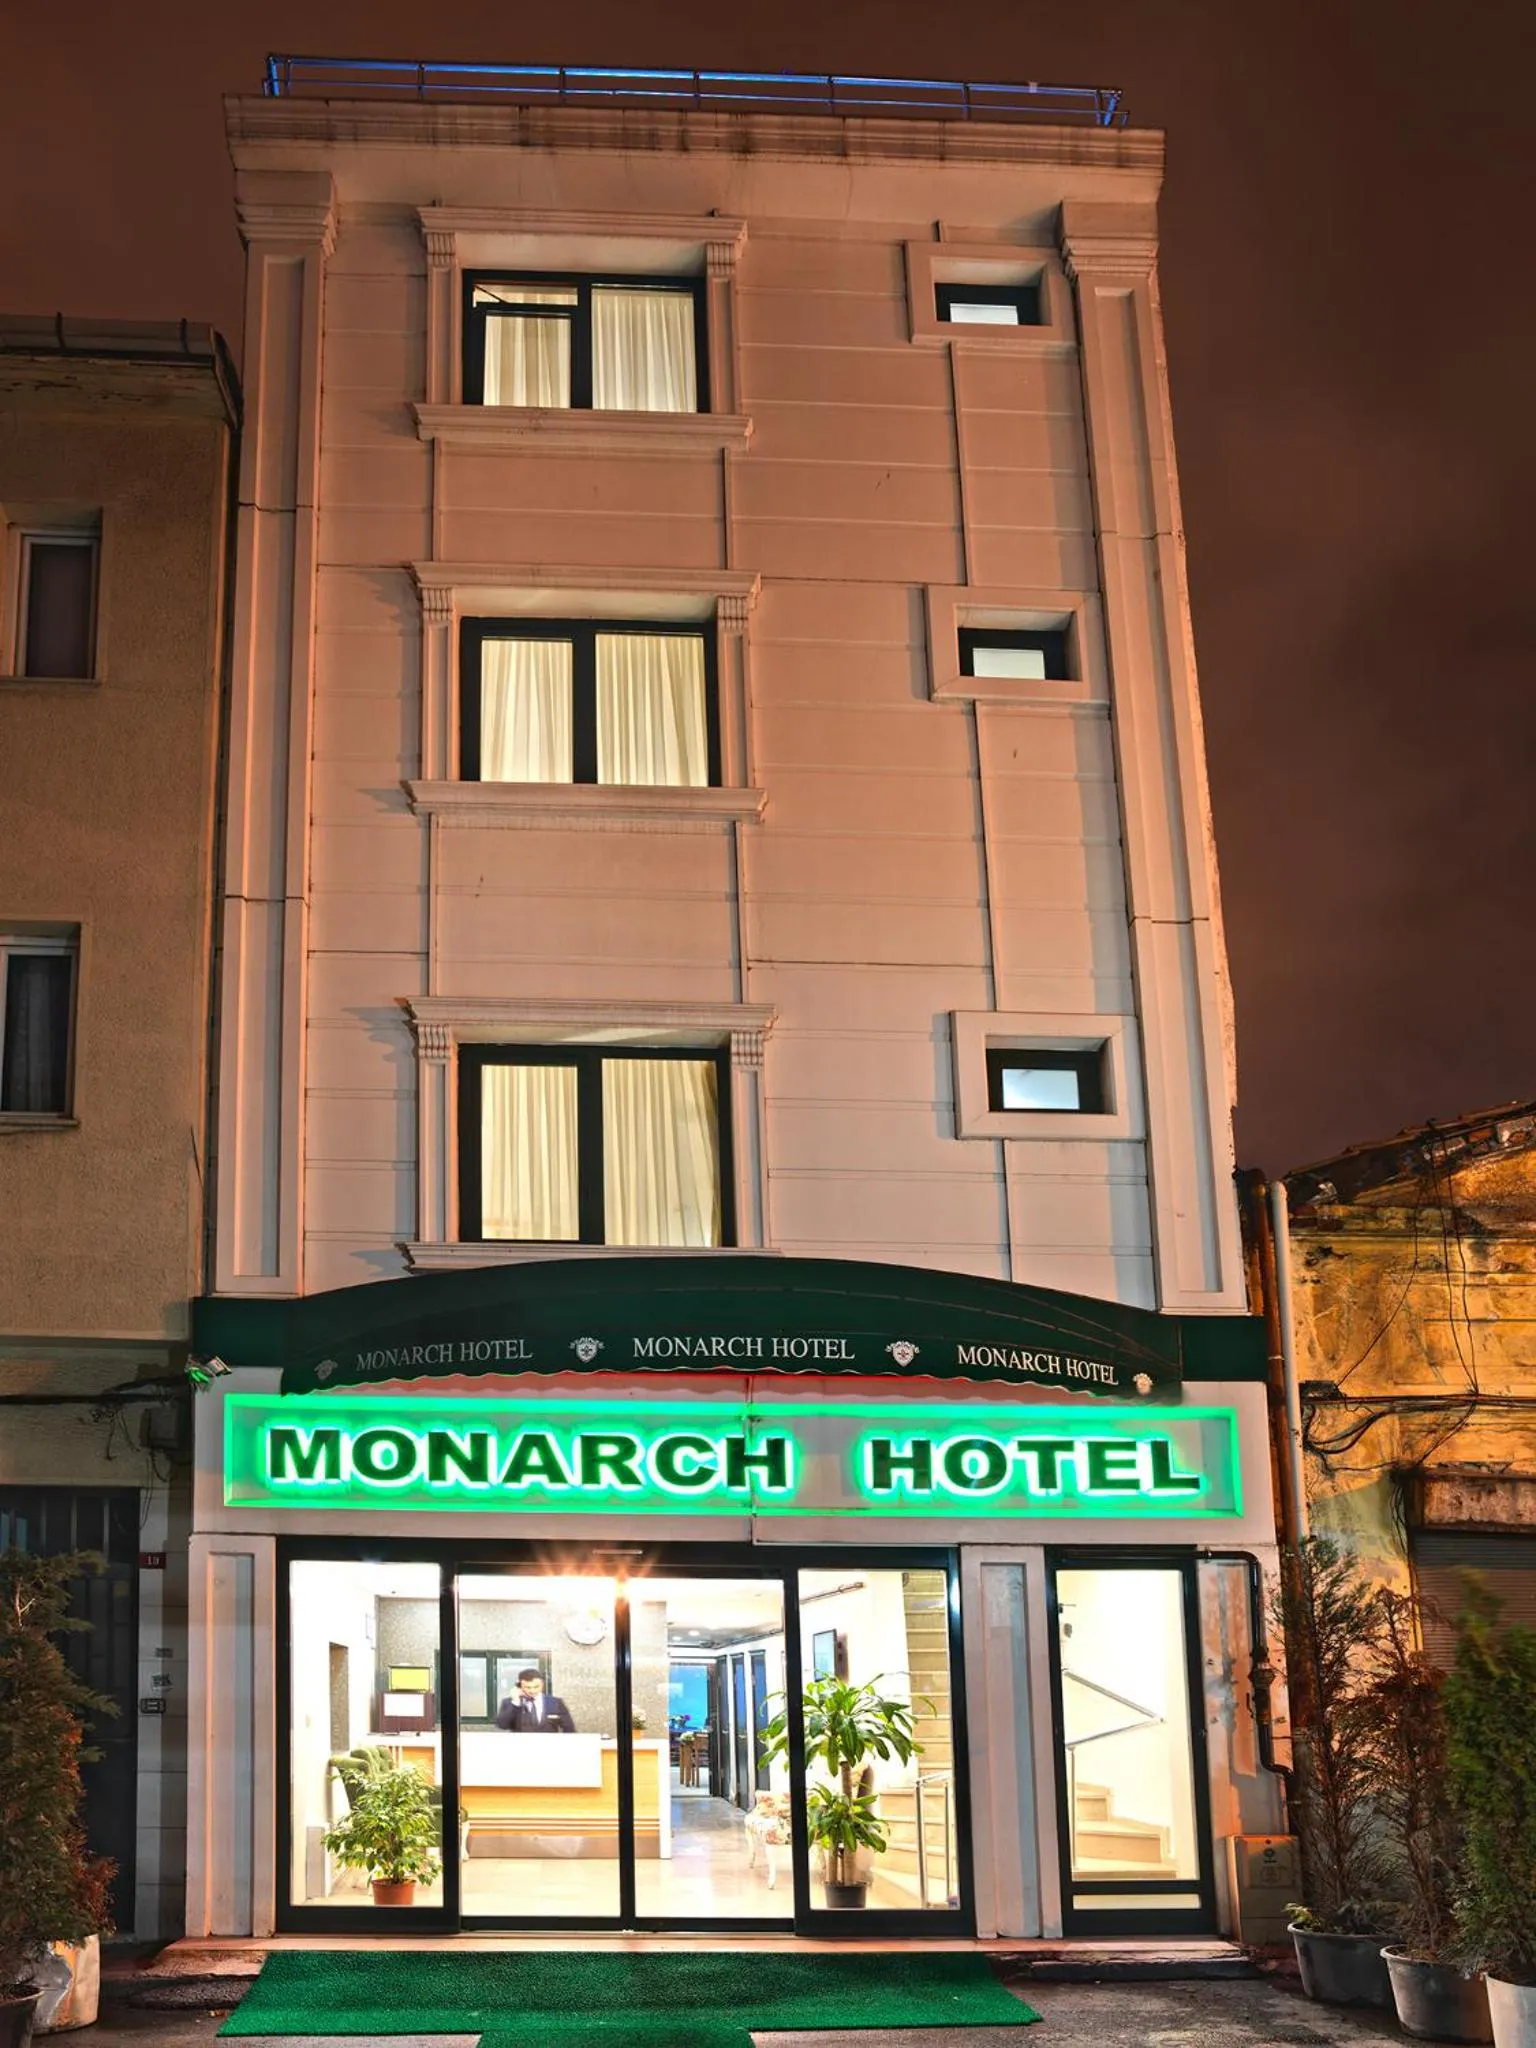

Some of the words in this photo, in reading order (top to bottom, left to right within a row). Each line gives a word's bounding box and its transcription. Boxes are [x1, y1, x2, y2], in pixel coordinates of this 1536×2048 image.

[356, 1343, 453, 1371] MONARCH
[460, 1339, 534, 1362] HOTEL
[633, 1337, 764, 1358] MONARCH
[771, 1337, 856, 1360] HOTEL
[957, 1344, 1062, 1375] MONARCH
[1066, 1358, 1119, 1386] HOTEL
[266, 1426, 788, 1490] MONARCH
[870, 1437, 1201, 1492] HOTEL
